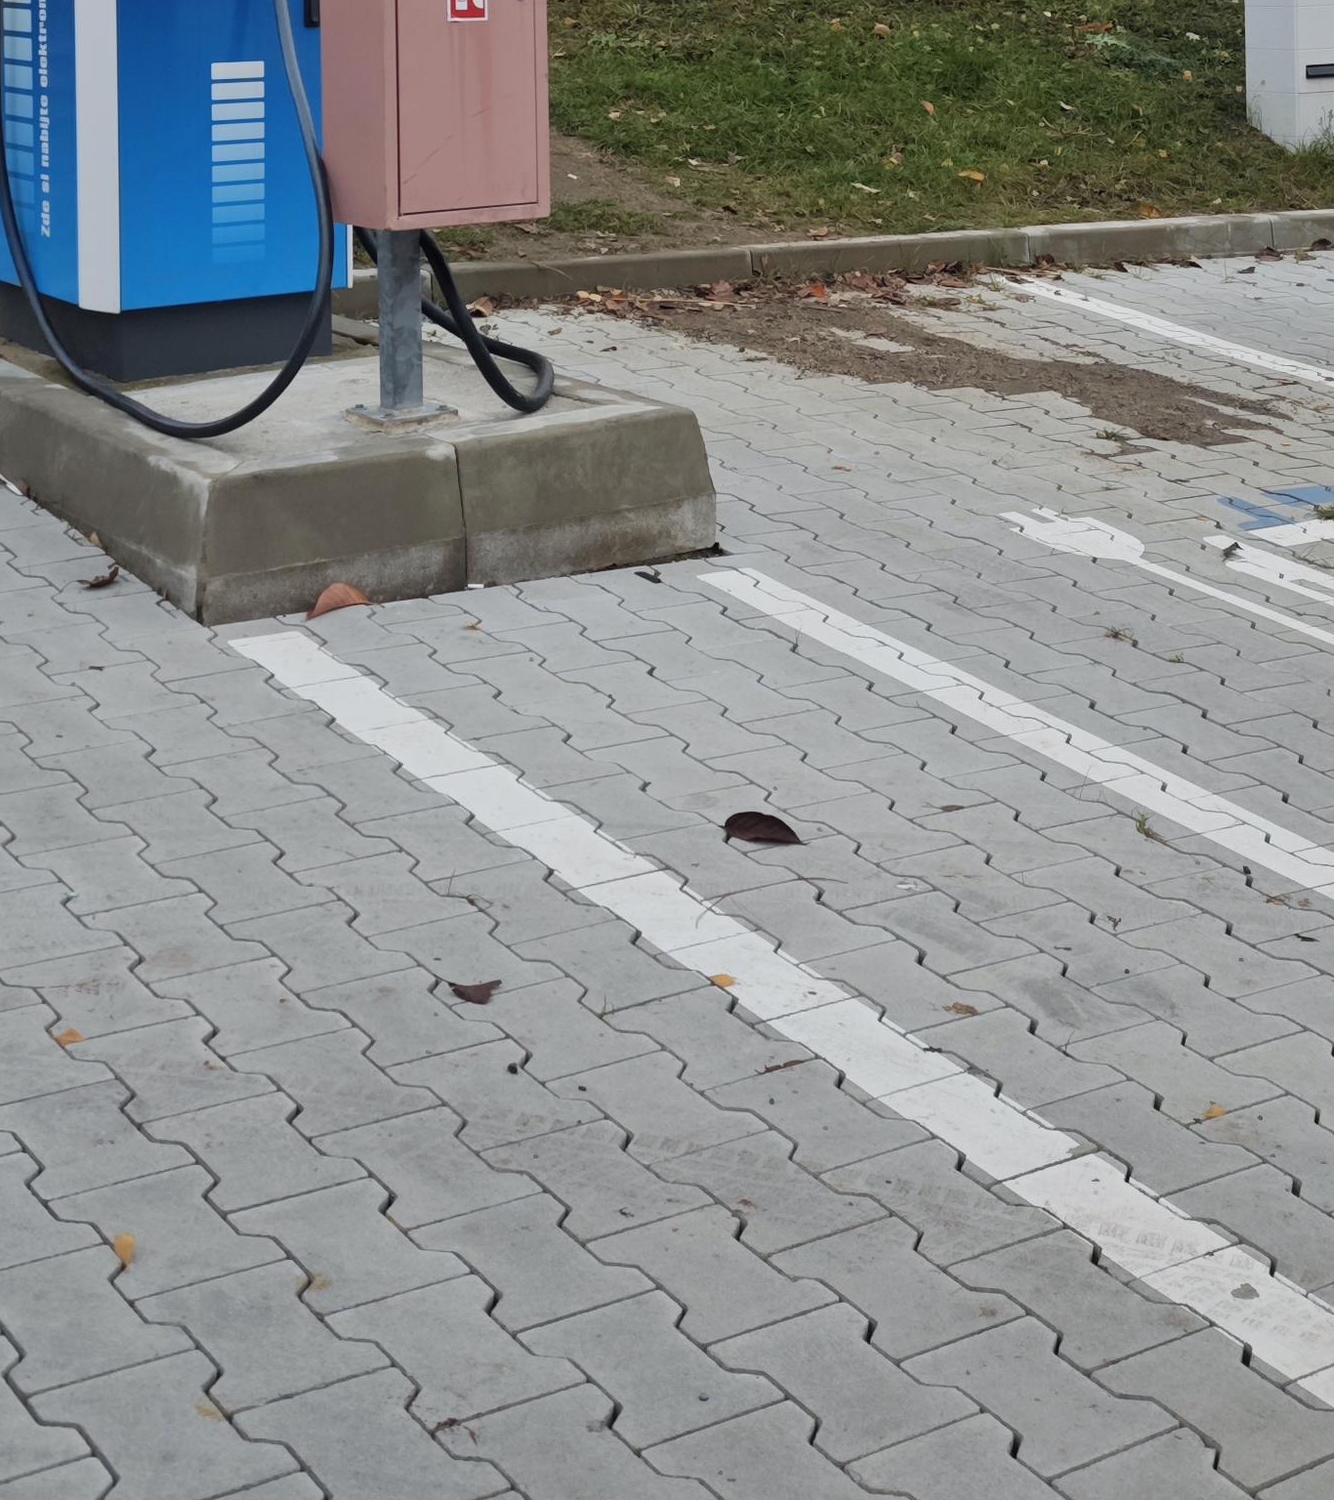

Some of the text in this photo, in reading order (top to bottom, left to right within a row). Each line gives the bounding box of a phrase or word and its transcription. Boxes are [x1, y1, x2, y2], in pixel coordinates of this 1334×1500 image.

[39, 95, 50, 168] nabijte
[40, 173, 50, 193] si
[41, 200, 51, 238] Zde
